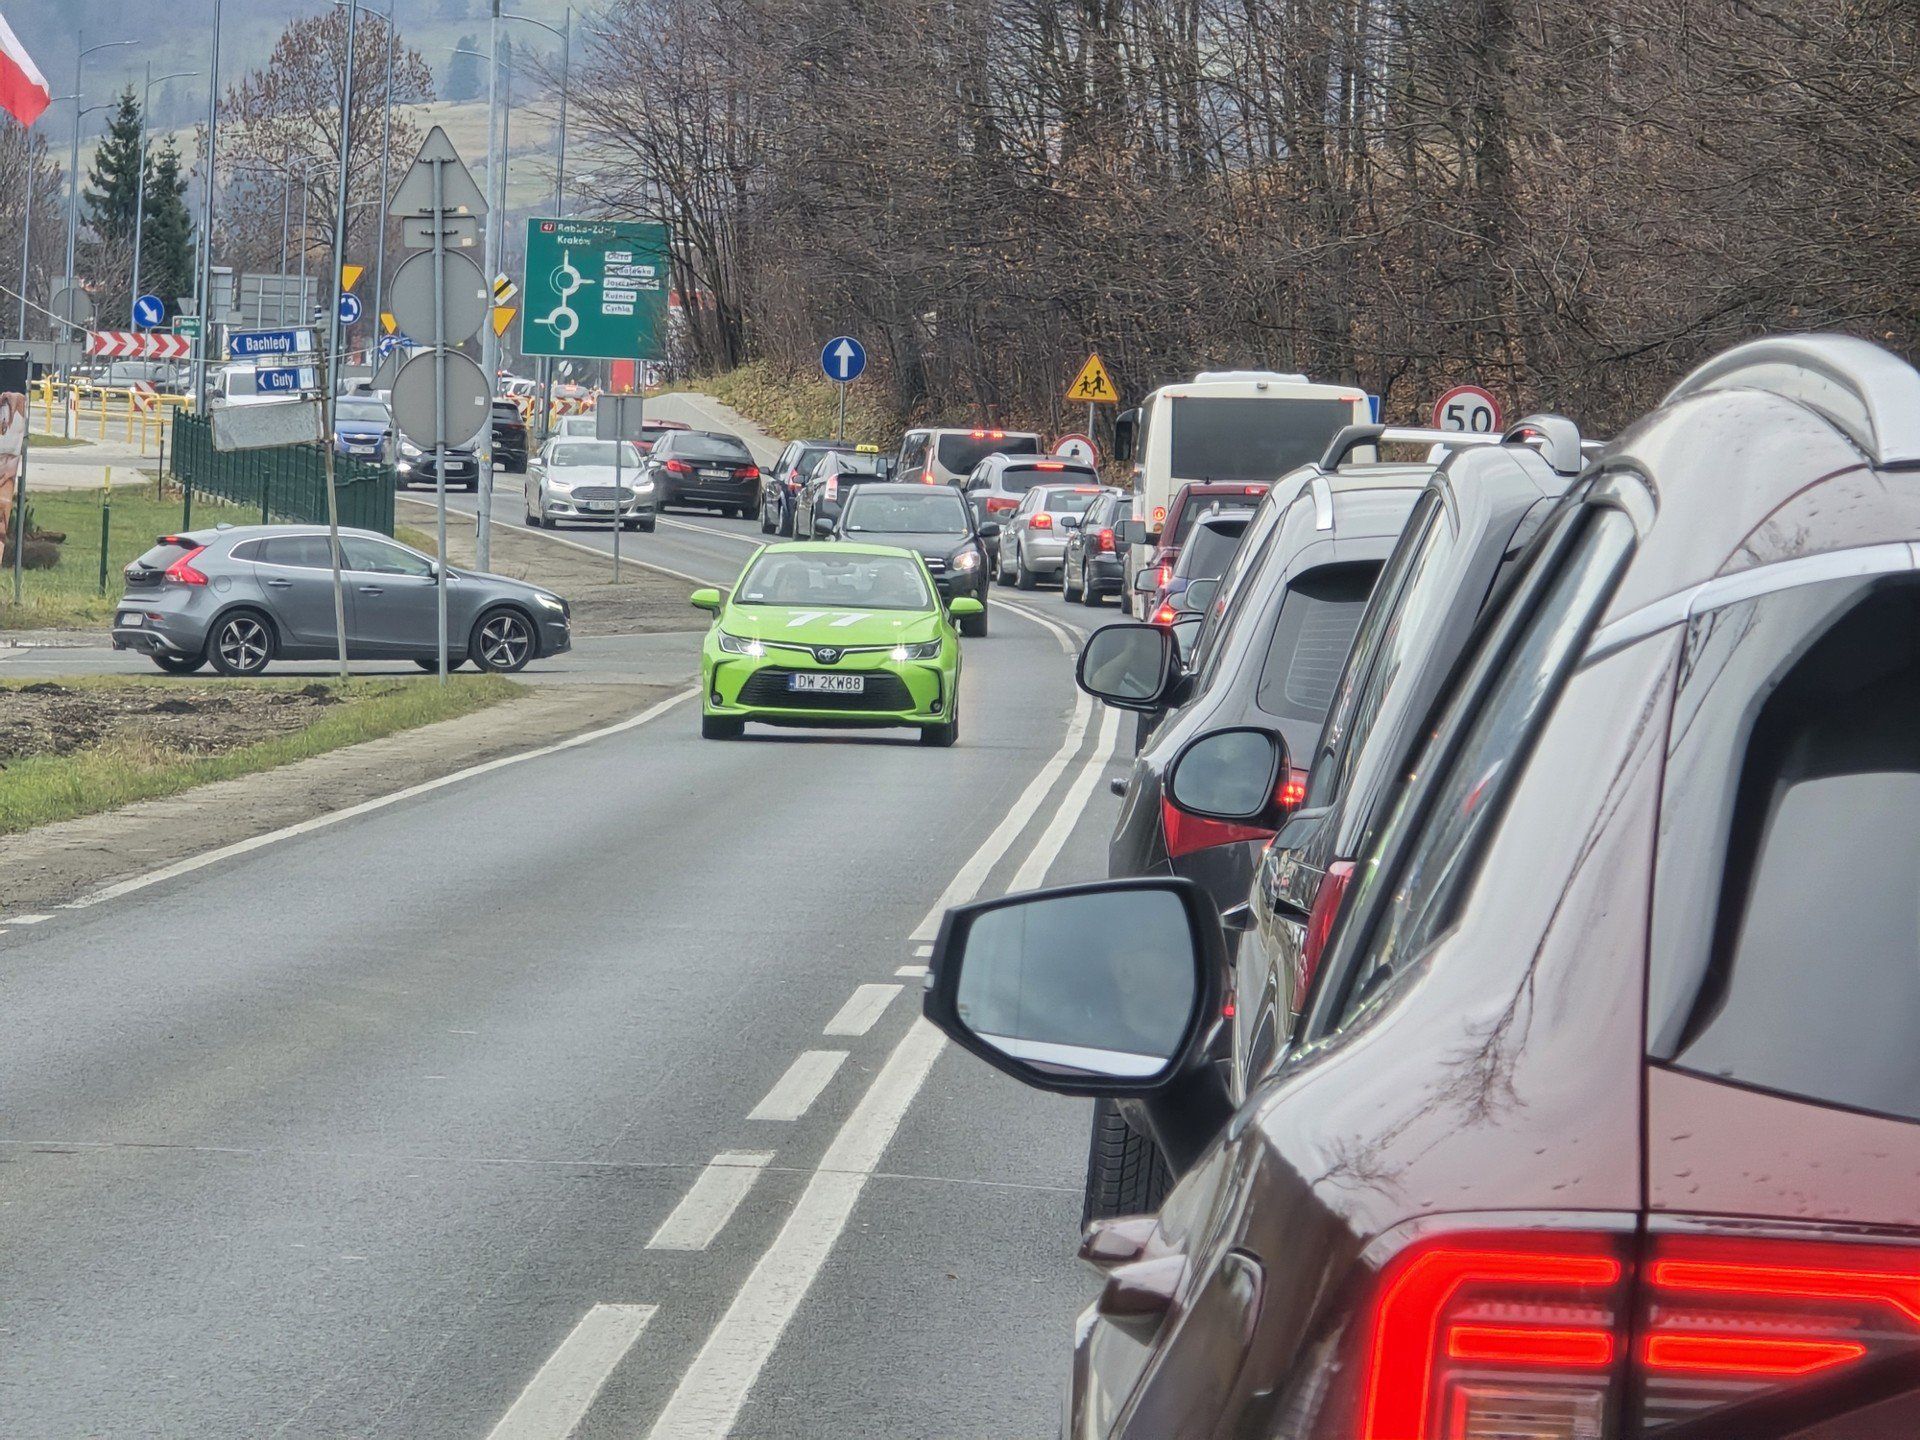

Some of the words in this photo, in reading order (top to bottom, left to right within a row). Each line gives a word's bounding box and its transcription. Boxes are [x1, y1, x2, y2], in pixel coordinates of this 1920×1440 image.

[543, 223, 553, 231] 47
[557, 235, 591, 245] Kraków
[245, 336, 290, 352] Bachledy
[272, 373, 294, 388] Guty
[1447, 405, 1492, 432] 50
[799, 675, 815, 687] DW
[820, 676, 861, 690] 2KW88
